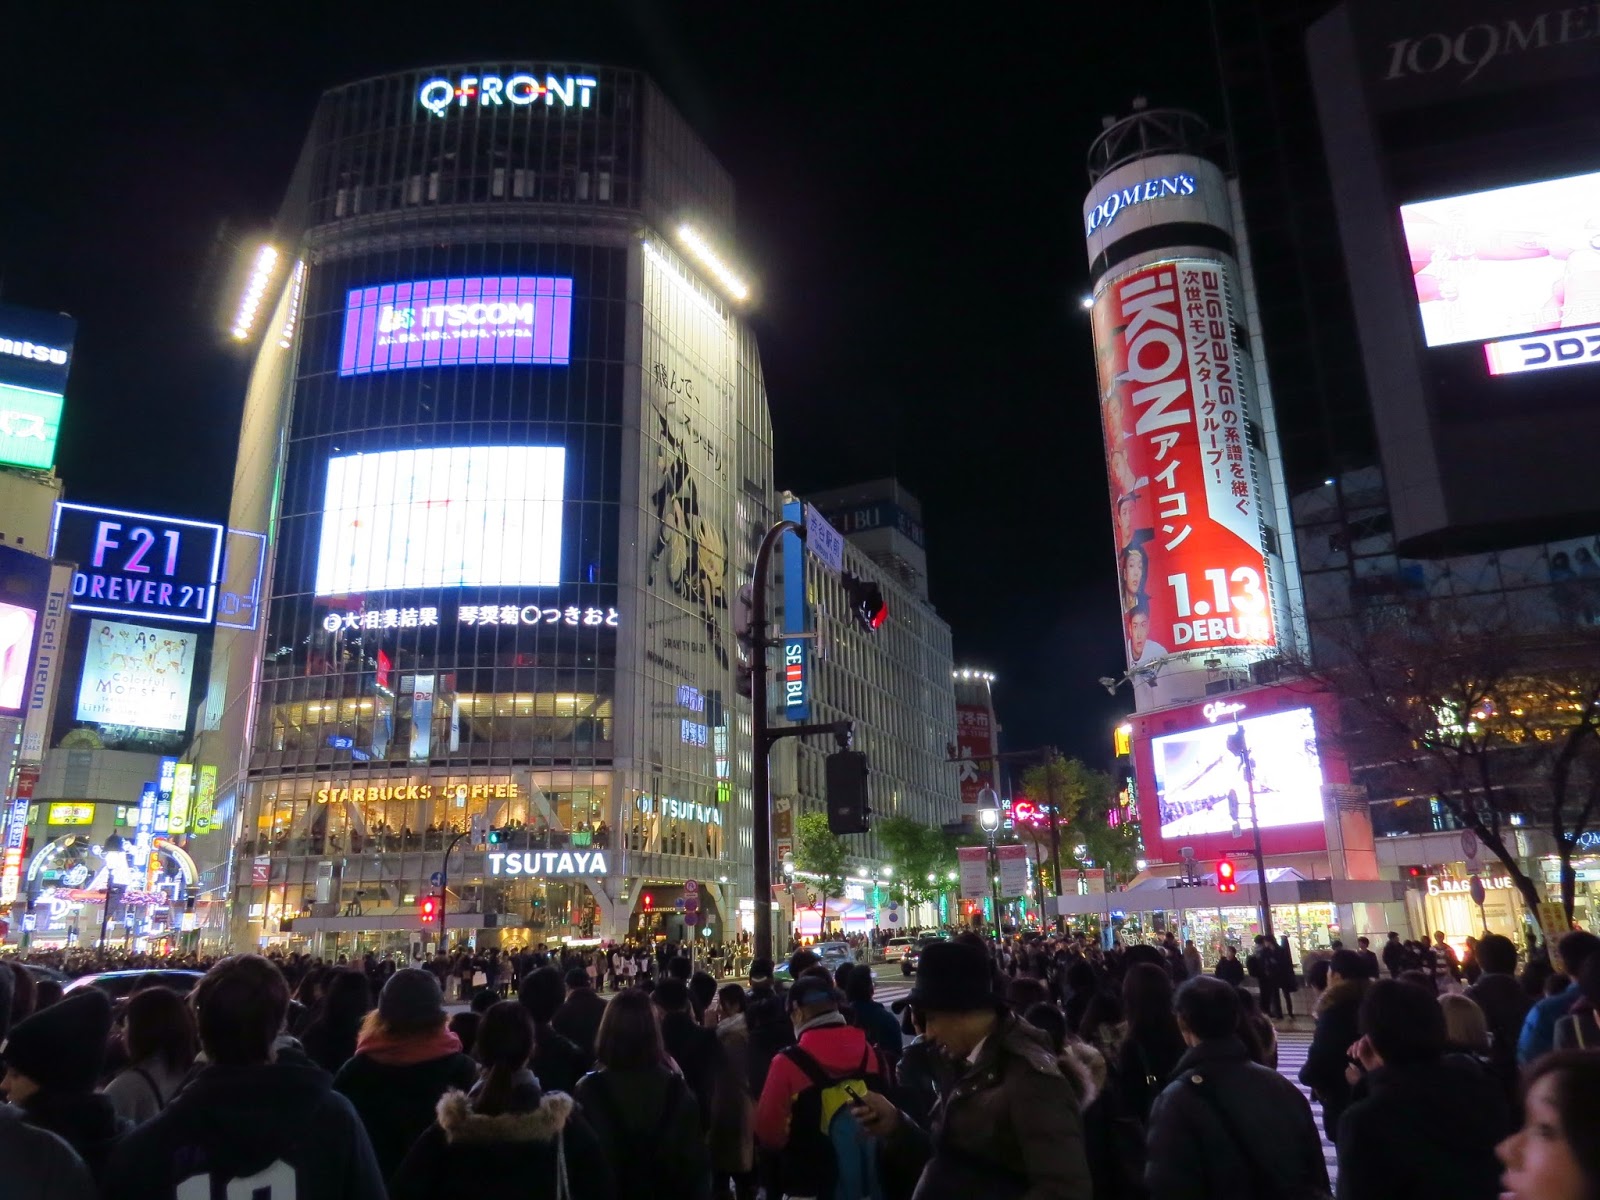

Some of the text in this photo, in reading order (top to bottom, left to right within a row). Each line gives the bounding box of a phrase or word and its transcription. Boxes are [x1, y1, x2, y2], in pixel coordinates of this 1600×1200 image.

[420, 74, 597, 117] QFRONT
[1151, 431, 1193, 551] アイコン
[93, 520, 181, 577] F21
[178, 586, 206, 610] 21
[1168, 566, 1267, 617] 1.13
[31, 656, 51, 710] neon
[96, 678, 177, 701] Monstr
[786, 644, 803, 706] SEIBU
[317, 783, 518, 804] STARBUCKS COFFEE
[661, 797, 721, 825] TSUTAYA
[489, 853, 607, 875] TSUTAYA
[1442, 876, 1513, 892] RAGLUE
